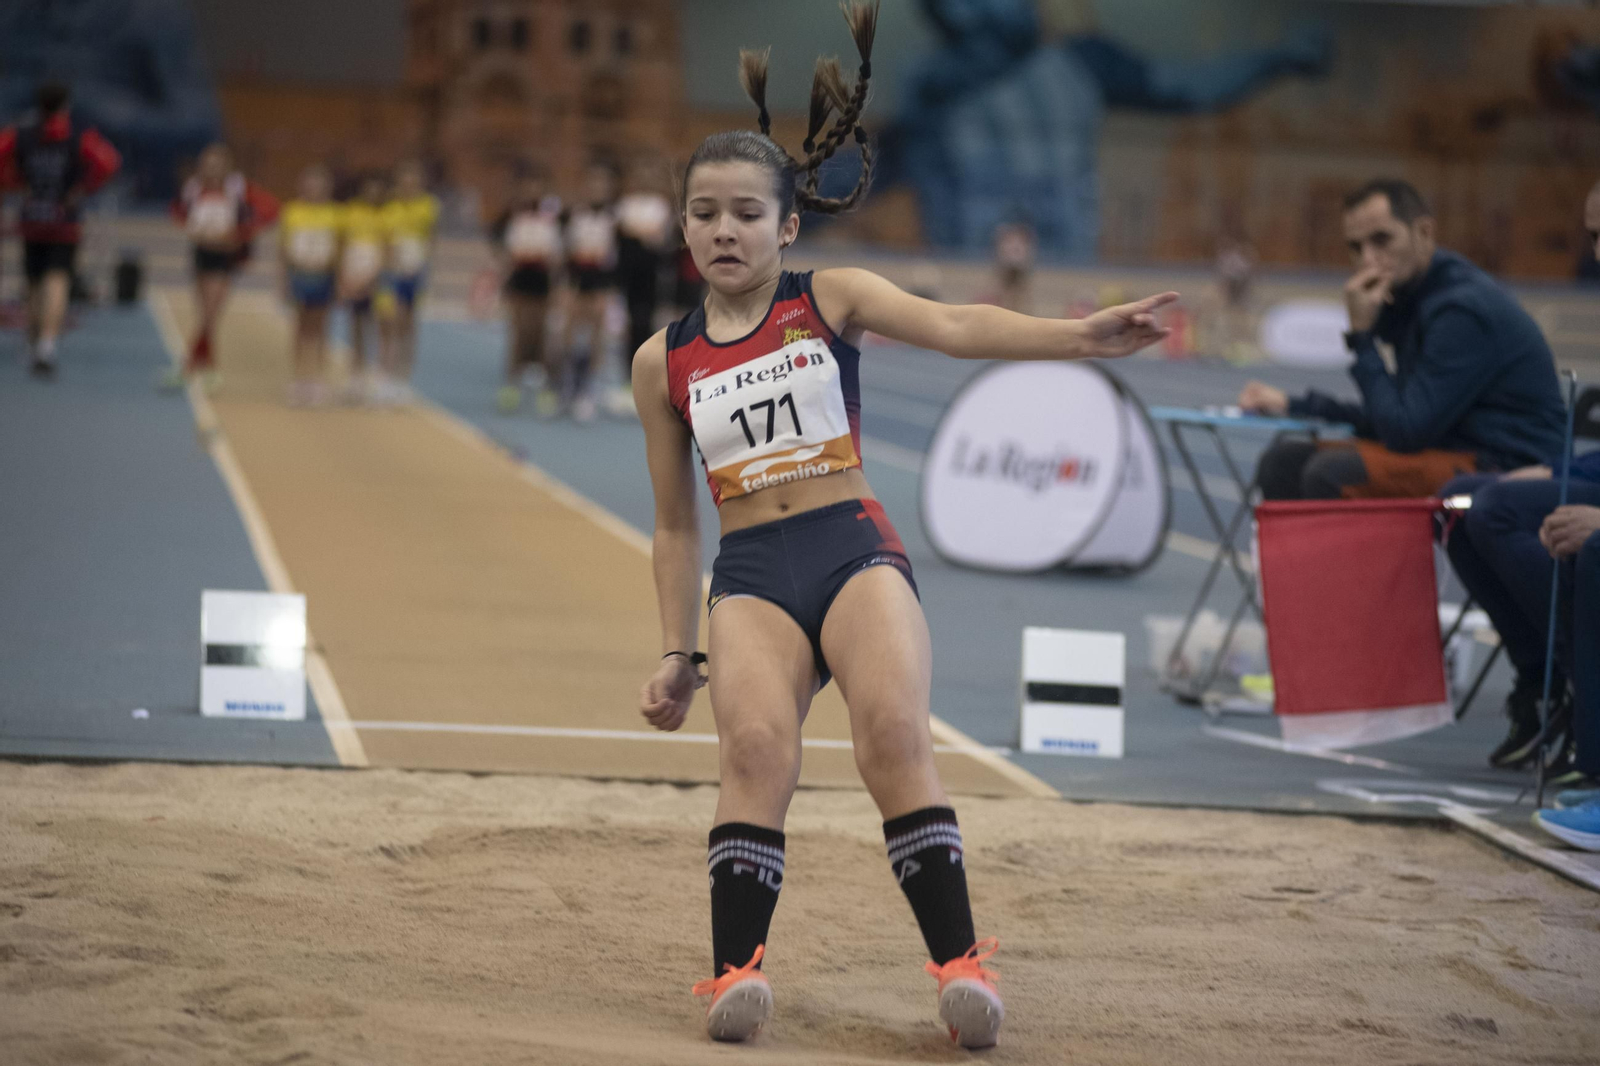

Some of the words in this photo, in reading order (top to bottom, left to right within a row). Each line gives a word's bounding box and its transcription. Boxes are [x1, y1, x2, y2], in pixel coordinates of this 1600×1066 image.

[694, 383, 727, 404] La
[730, 392, 802, 448] 171
[742, 461, 830, 493] telemiño
